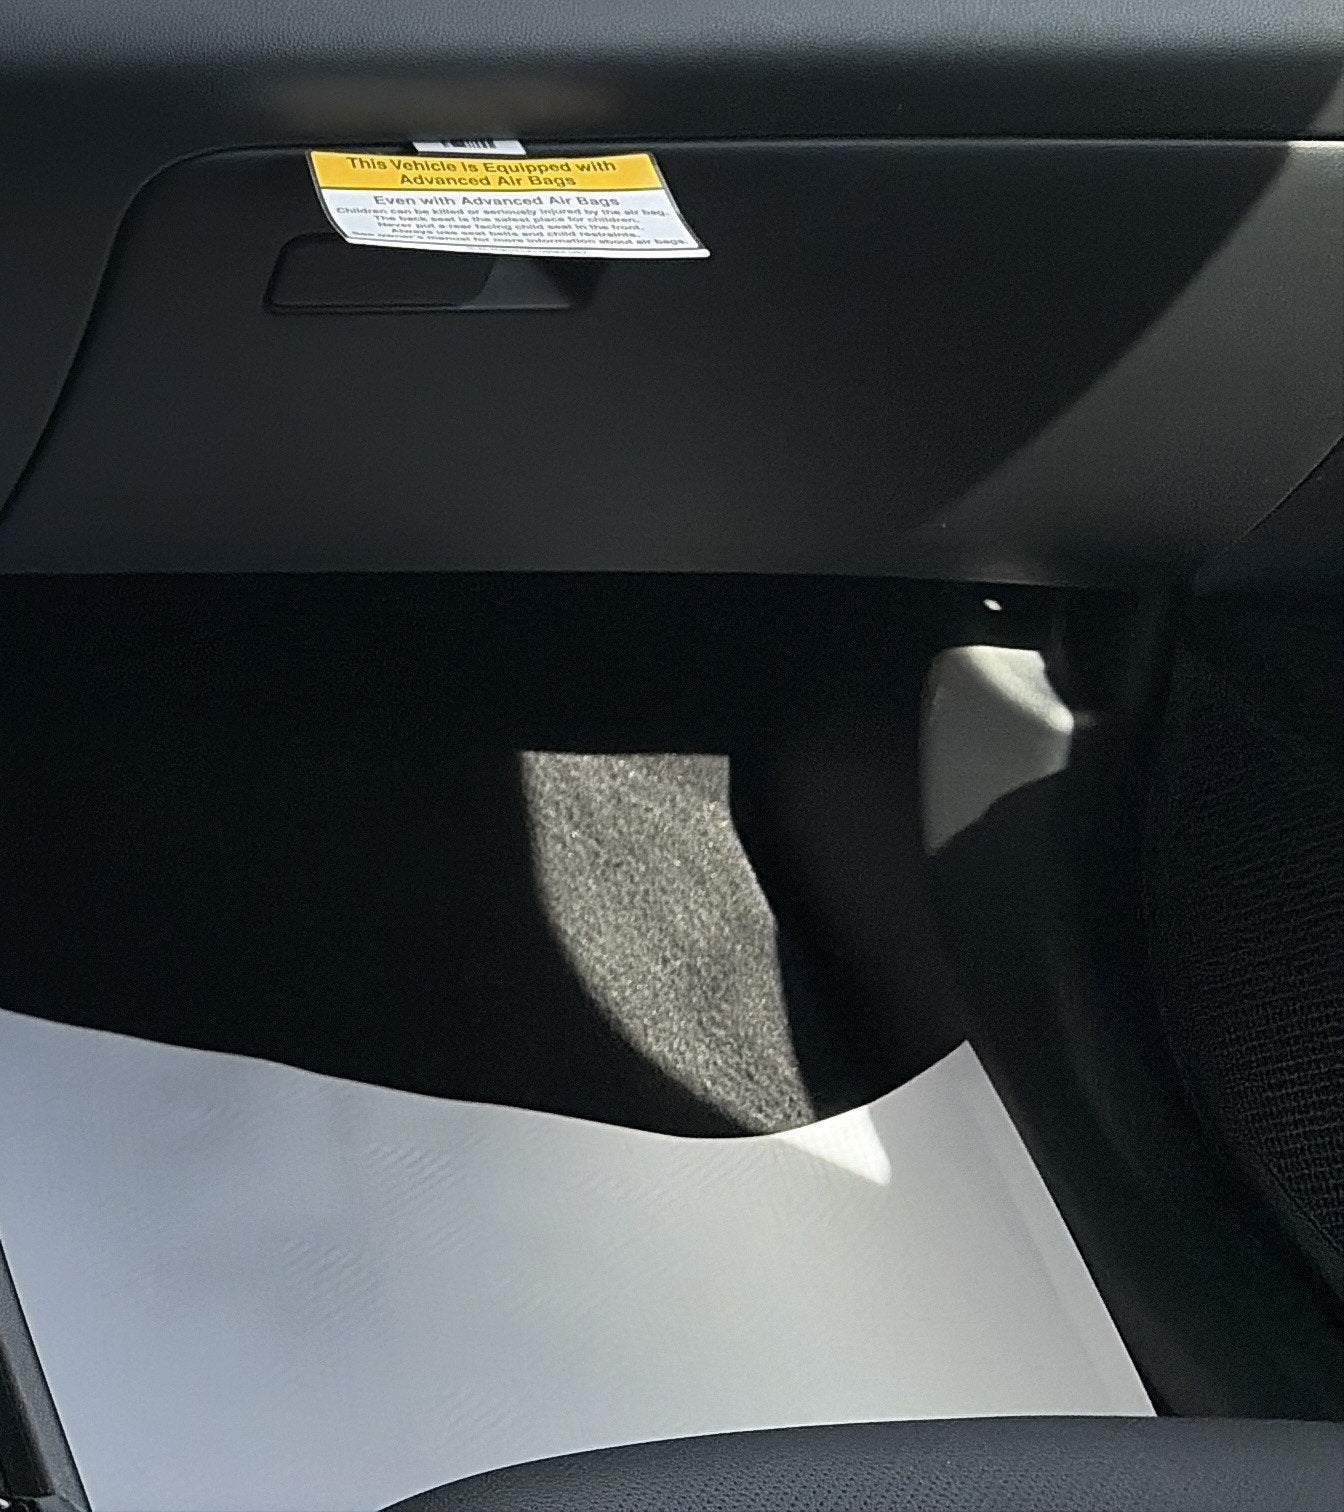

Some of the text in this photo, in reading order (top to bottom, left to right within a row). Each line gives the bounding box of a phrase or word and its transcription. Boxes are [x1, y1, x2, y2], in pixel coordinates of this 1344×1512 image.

[346, 157, 388, 170] This
[389, 159, 457, 173] Vehicle
[484, 162, 572, 176] Equipped
[575, 160, 616, 172] with
[400, 174, 577, 187] Advanced Air Bags
[373, 196, 620, 207] Even with Advanced Air Bags
[336, 207, 387, 215] Children
